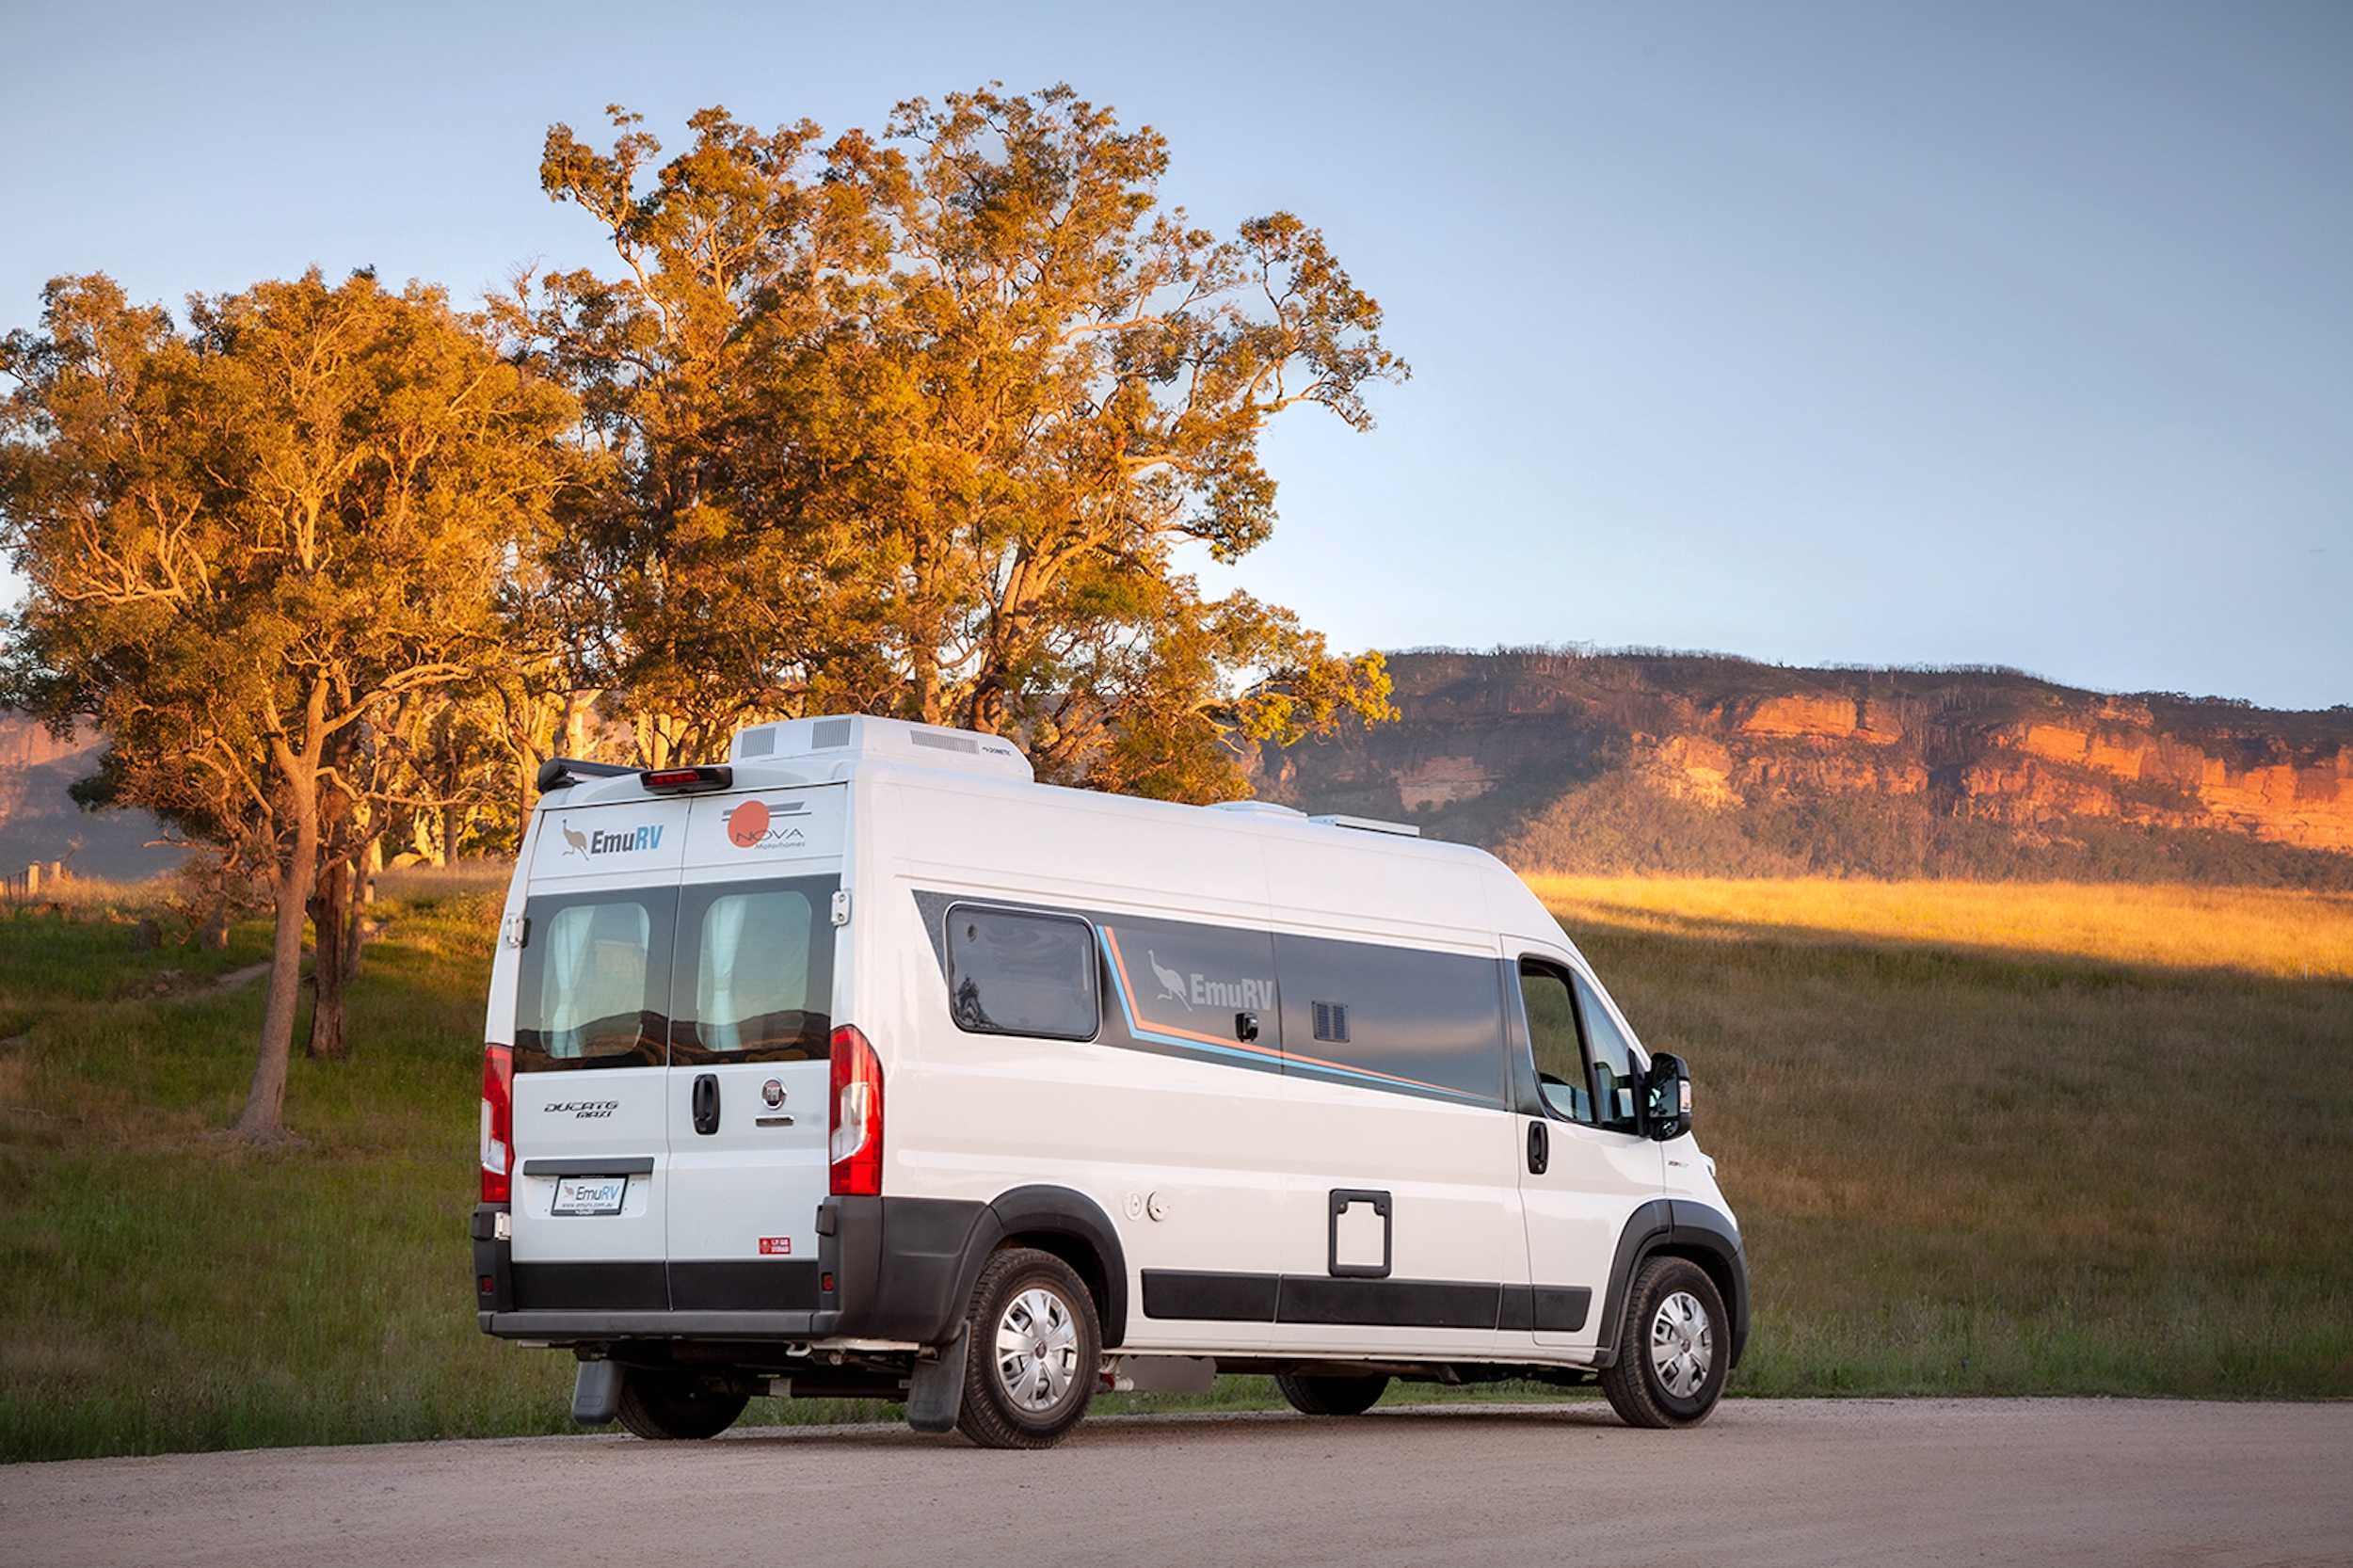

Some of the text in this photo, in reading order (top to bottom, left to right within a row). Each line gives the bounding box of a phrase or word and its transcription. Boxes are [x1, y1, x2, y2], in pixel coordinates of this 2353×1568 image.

[591, 824, 664, 855] EmuRV
[736, 828, 804, 842] NOVA
[1190, 973, 1273, 1010] EmuRV
[544, 1101, 618, 1112] DUCATO
[576, 1185, 620, 1201] EmuRV
